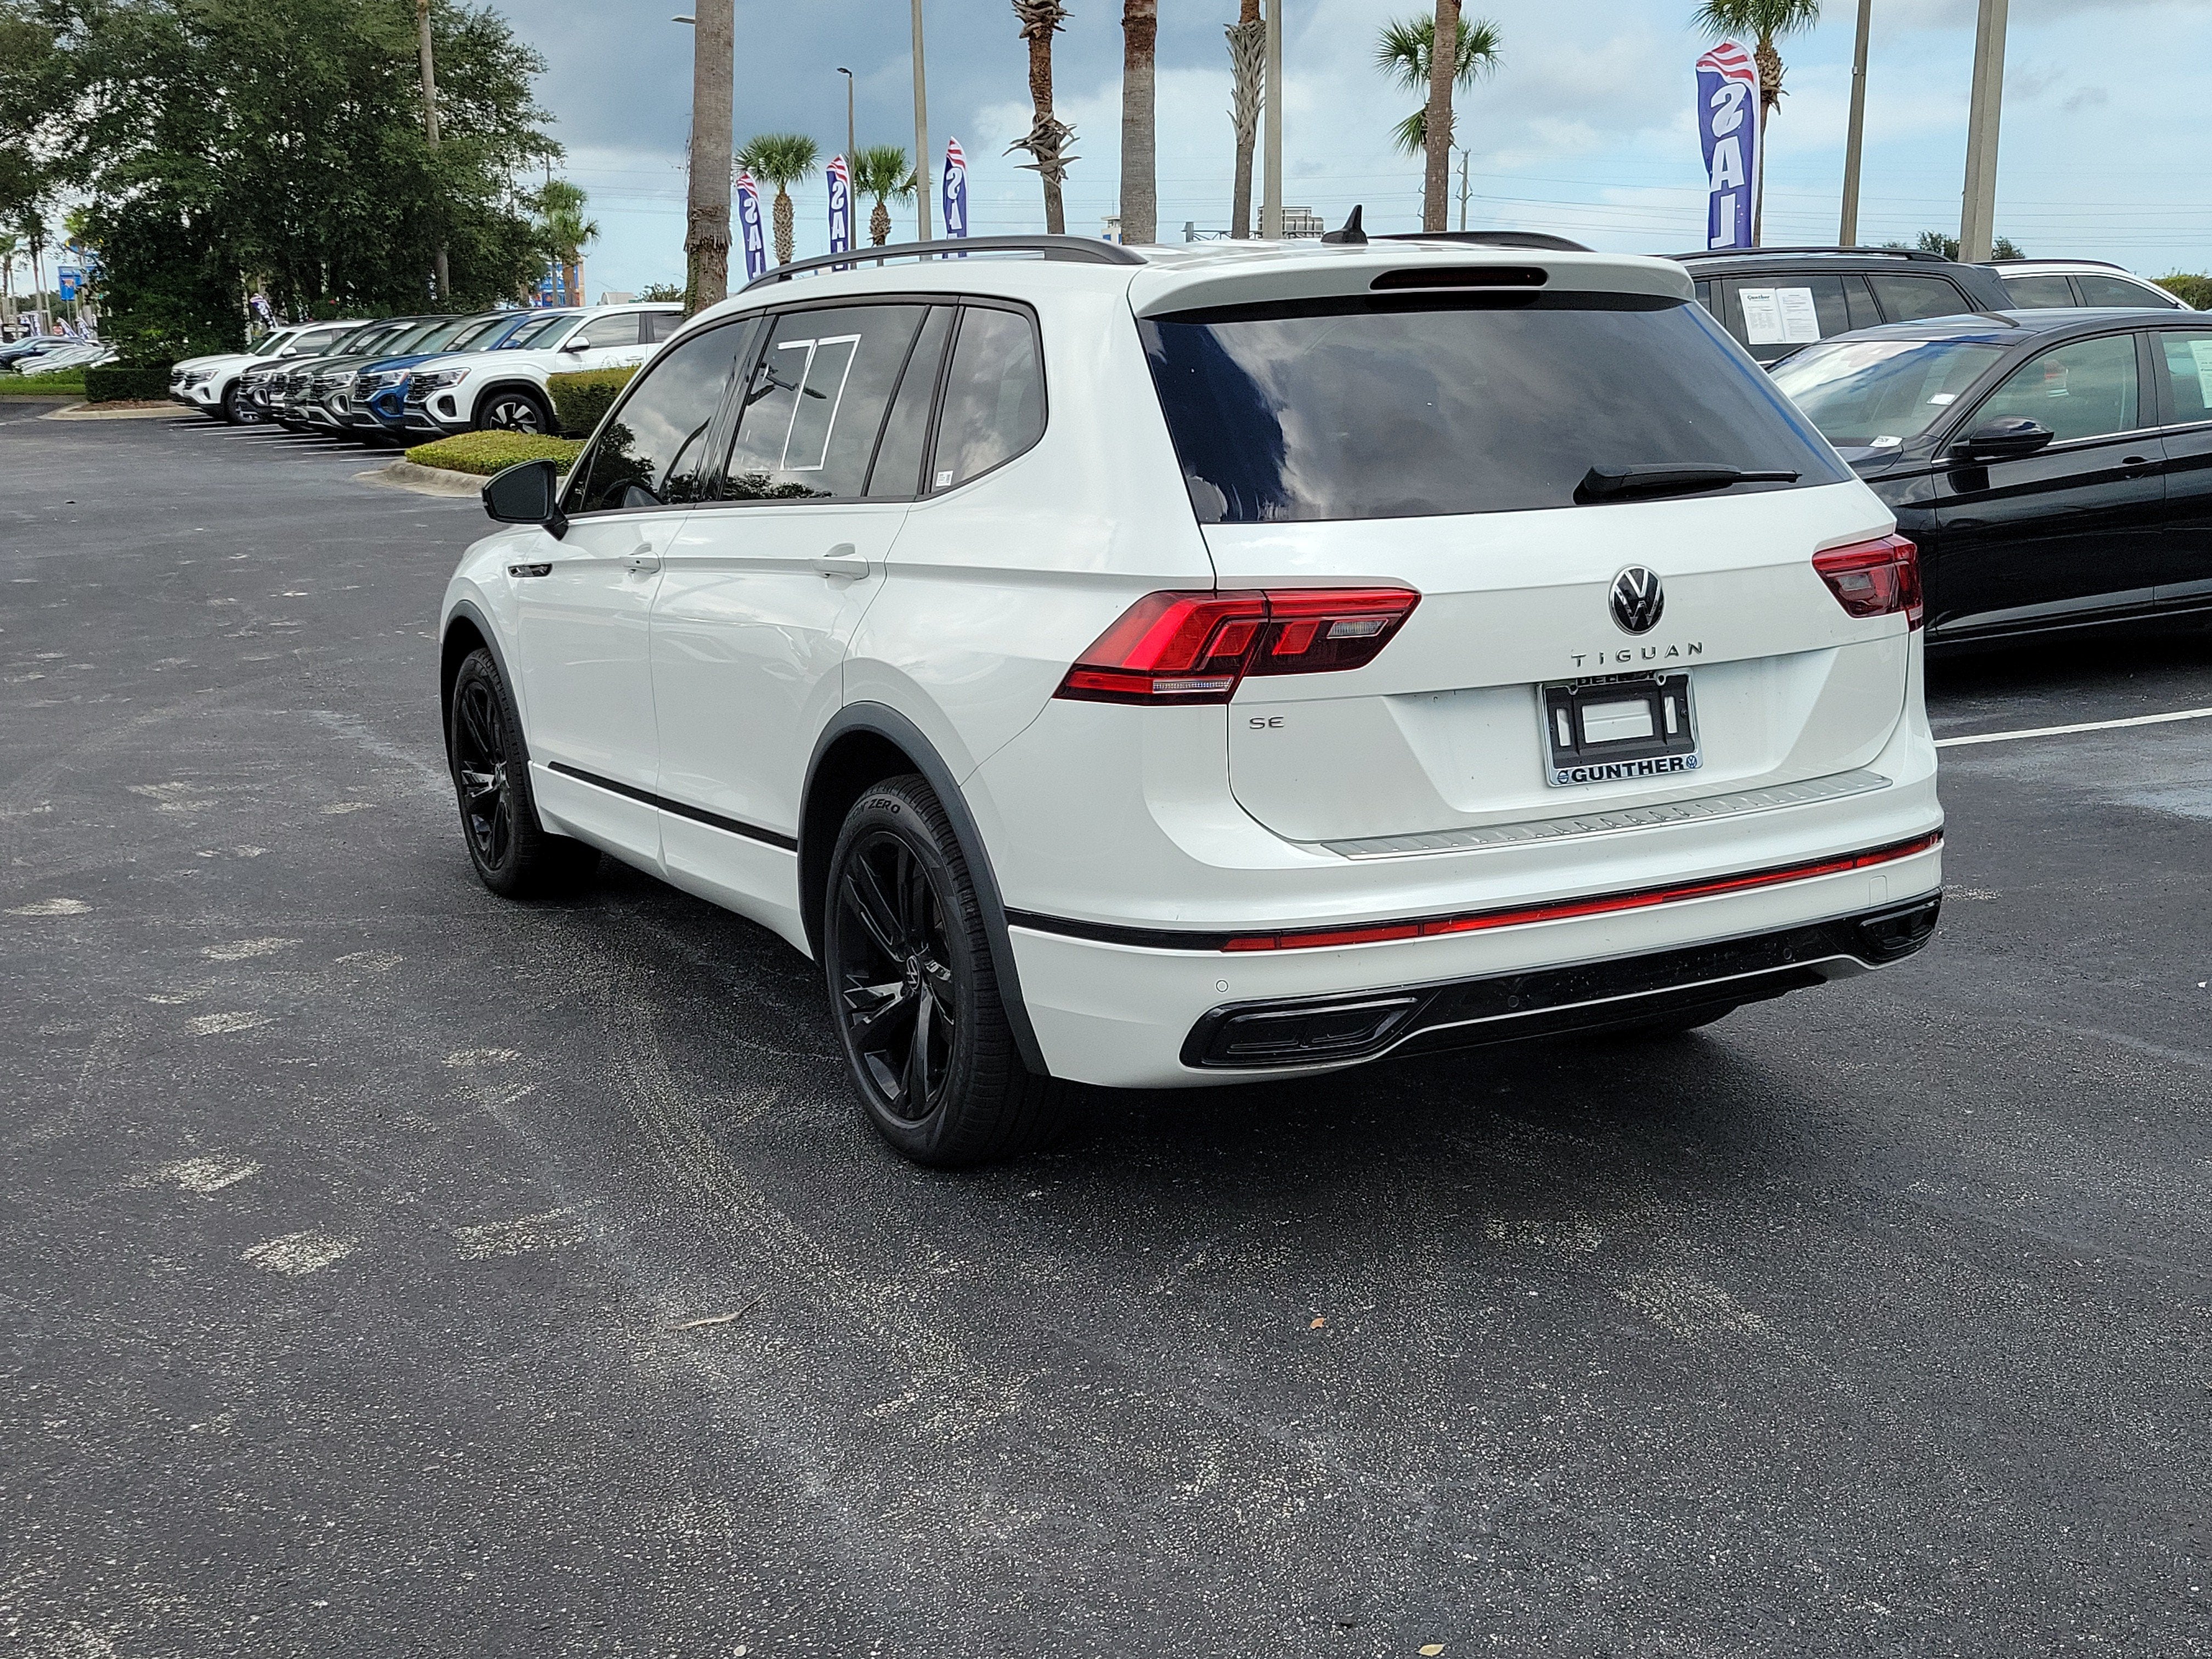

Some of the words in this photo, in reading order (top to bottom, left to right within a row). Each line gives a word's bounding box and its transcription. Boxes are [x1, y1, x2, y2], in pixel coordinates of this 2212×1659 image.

[1571, 641, 1703, 668] TIGUAN
[1249, 715, 1285, 730] SE
[1571, 757, 1684, 783] GUNTHER
[868, 798, 901, 814] ZERO
